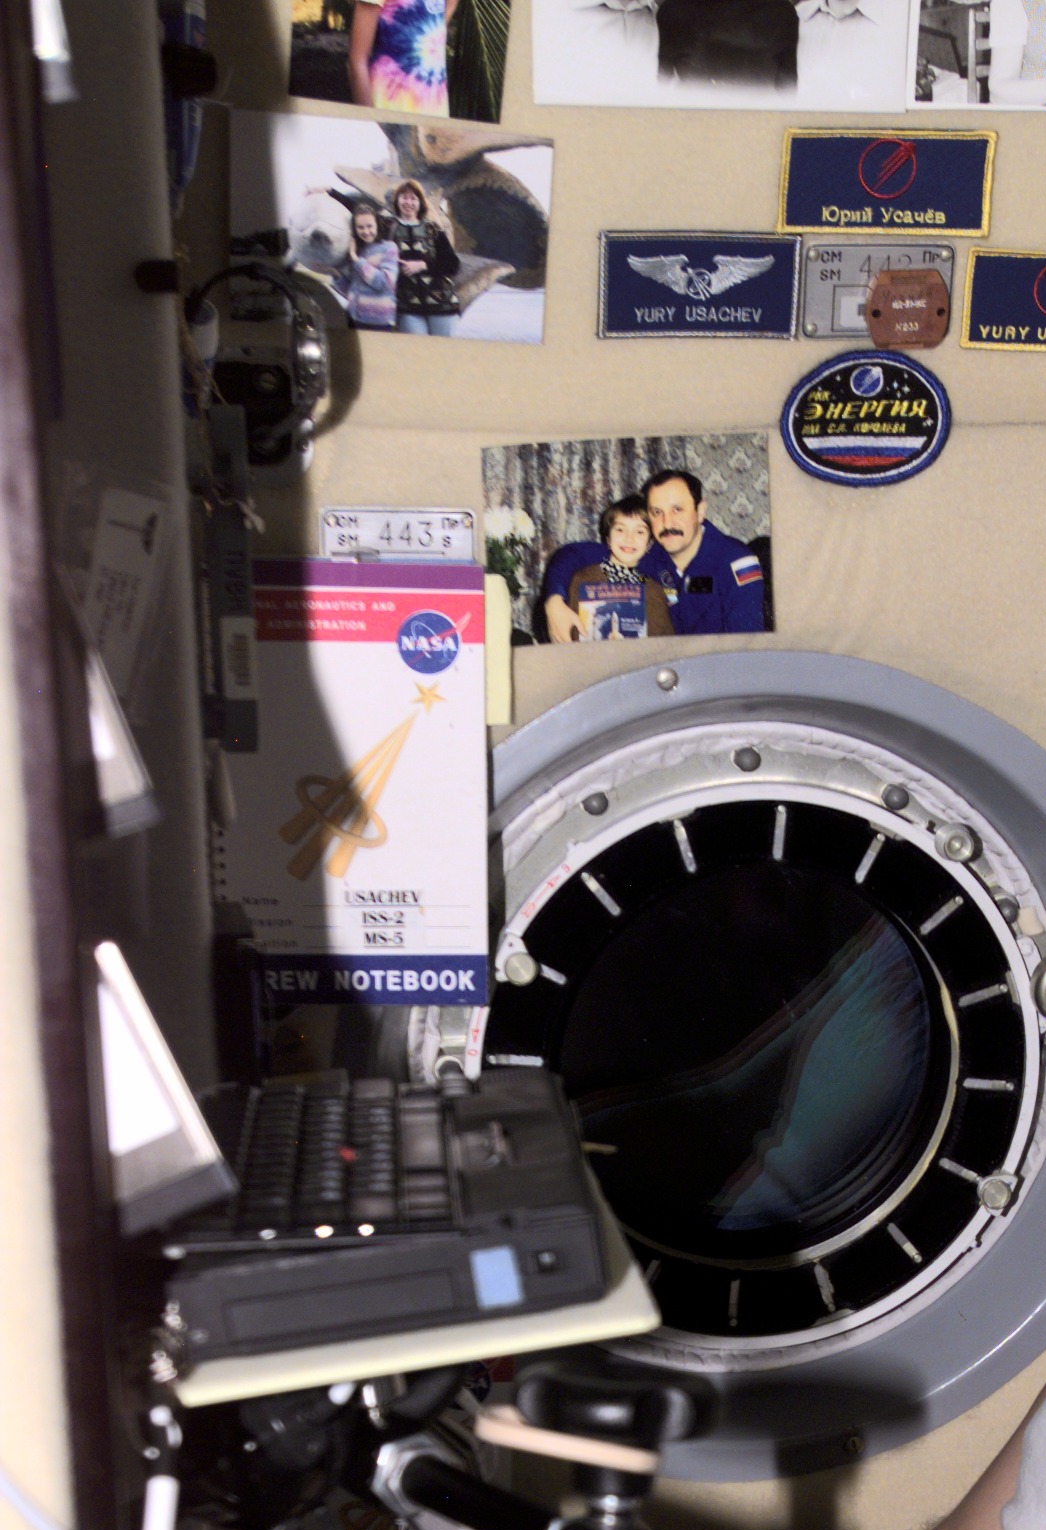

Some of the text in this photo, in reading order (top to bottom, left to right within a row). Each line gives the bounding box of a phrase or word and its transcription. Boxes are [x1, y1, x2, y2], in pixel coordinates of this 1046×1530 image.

[821, 205, 946, 226] Юрий Усачёв
[820, 268, 841, 282] SM
[634, 305, 762, 323] YURY USACHEV
[979, 324, 1030, 341] YURY
[803, 399, 928, 420] ЭНЕРГИЯ
[338, 533, 359, 547] SM
[378, 520, 434, 547] 443
[371, 601, 396, 612] AND
[401, 635, 458, 652] NASA
[343, 888, 422, 904] USACHEV
[361, 910, 405, 925] ISS-2
[363, 931, 404, 945] MS-5
[334, 968, 476, 991] NOTEBOOK
